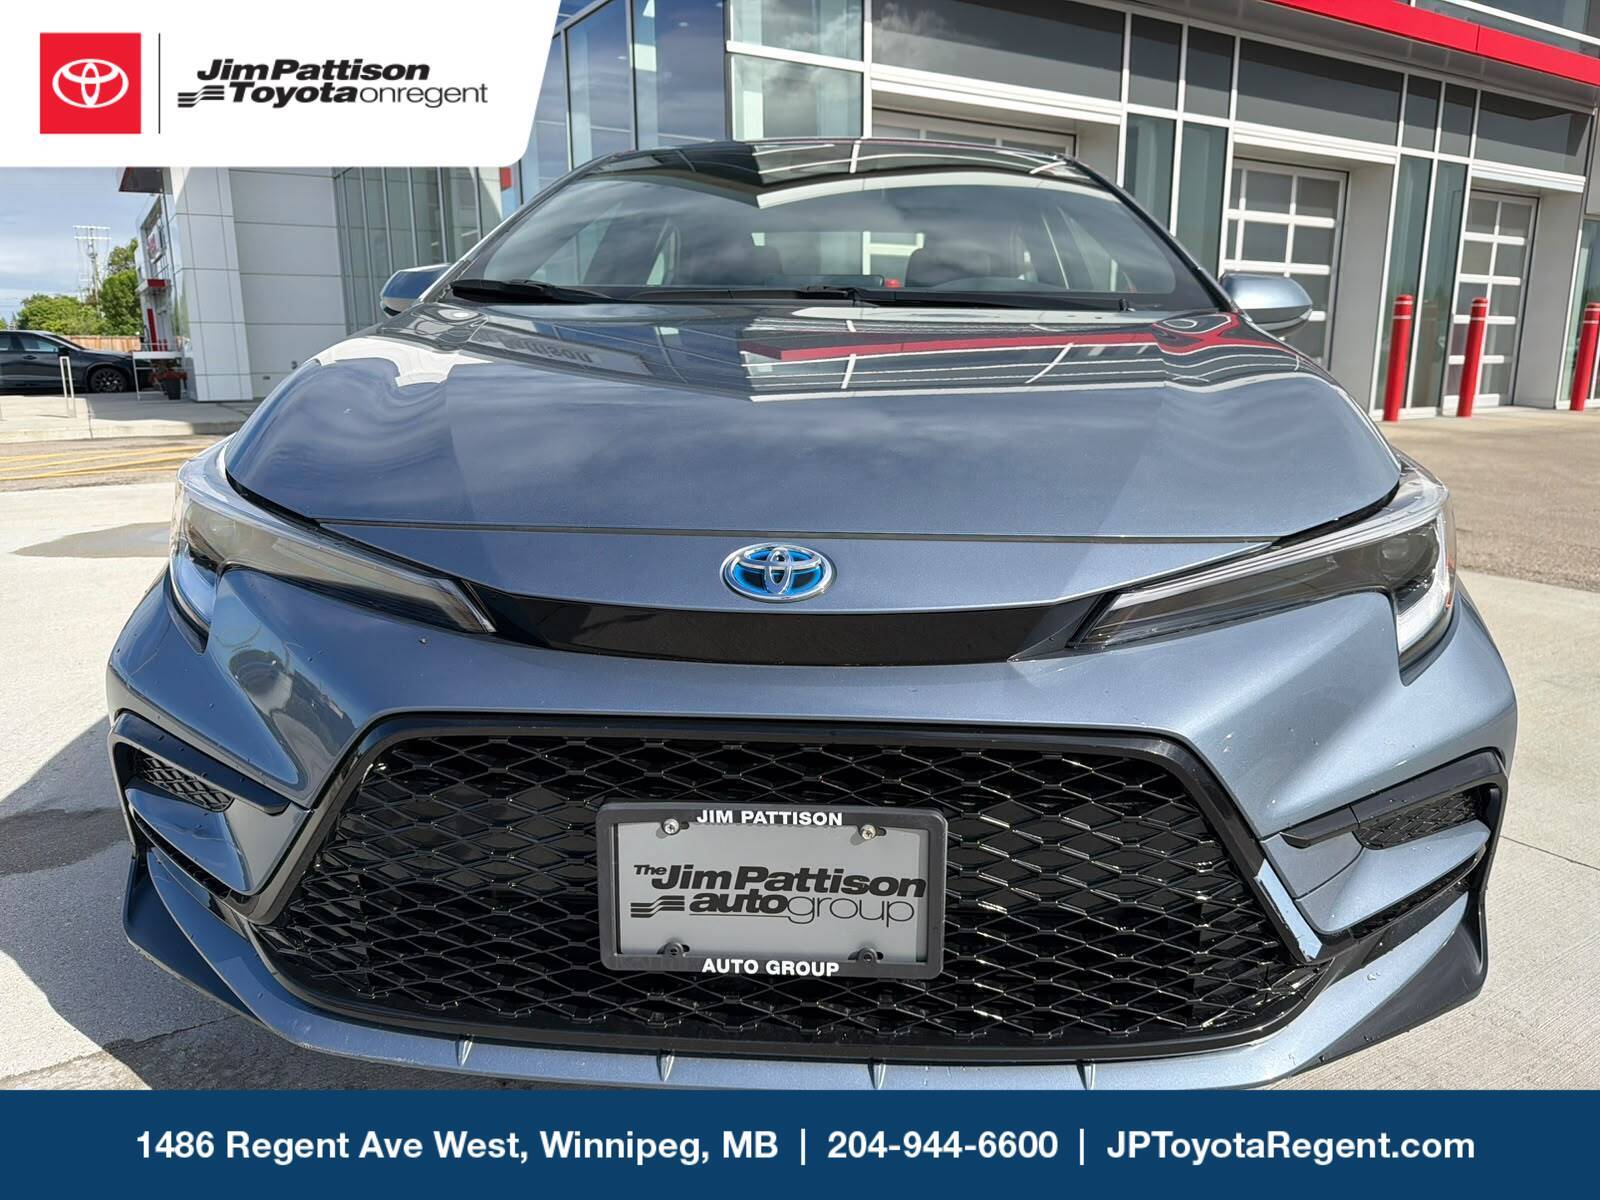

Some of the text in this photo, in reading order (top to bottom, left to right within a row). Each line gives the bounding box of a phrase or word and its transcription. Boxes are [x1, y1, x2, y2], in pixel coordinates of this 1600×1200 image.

[696, 809, 843, 827] JIM PATTISON
[633, 864, 667, 876] The
[702, 958, 840, 977] AUTO GROUP
